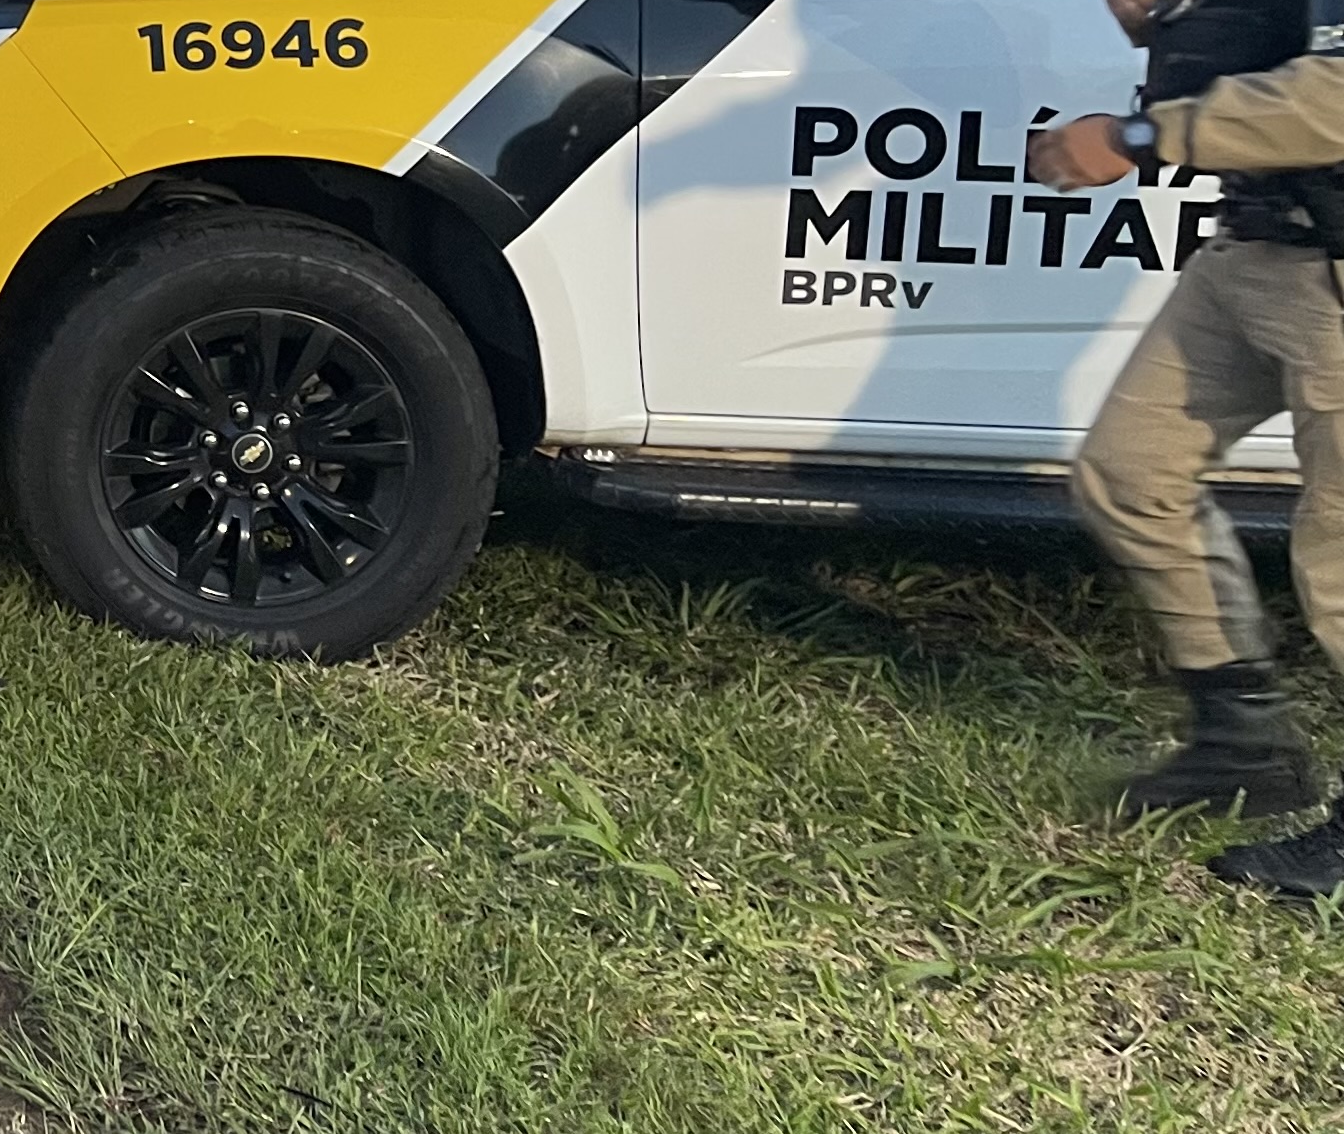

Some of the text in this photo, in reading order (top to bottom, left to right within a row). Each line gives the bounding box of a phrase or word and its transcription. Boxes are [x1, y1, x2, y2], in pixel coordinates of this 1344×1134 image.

[137, 18, 369, 72] 16946
[792, 105, 1216, 188] POLÍ
[782, 269, 934, 309] BPRv
